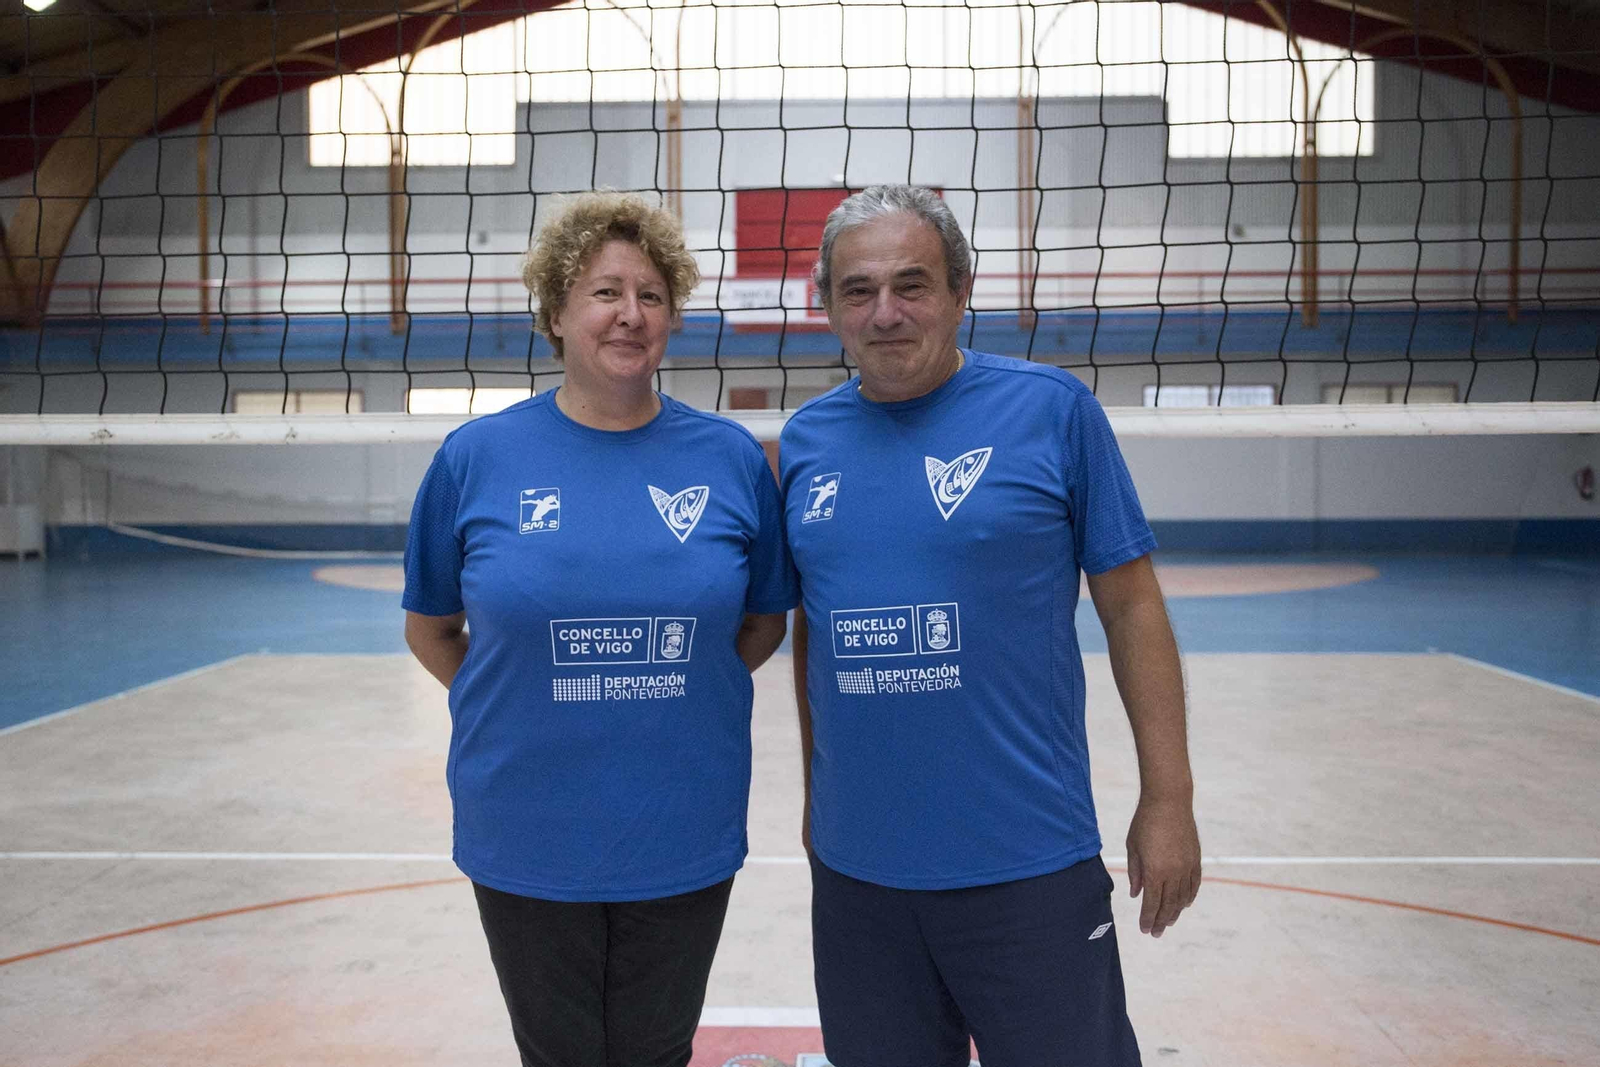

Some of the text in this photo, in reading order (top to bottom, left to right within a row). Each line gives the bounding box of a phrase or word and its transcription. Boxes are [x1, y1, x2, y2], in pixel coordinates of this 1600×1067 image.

[836, 617, 906, 633] CONCELLO
[559, 627, 643, 641] CONCELLO
[844, 633, 898, 647] DE VIGO
[570, 641, 633, 655] DE VIGO
[876, 662, 960, 682] DEPUTACIÓN
[604, 671, 686, 689] DEPUTACIÓN
[878, 677, 962, 694] PONTEVEDRA
[605, 686, 686, 701] PONTEVEDRA
